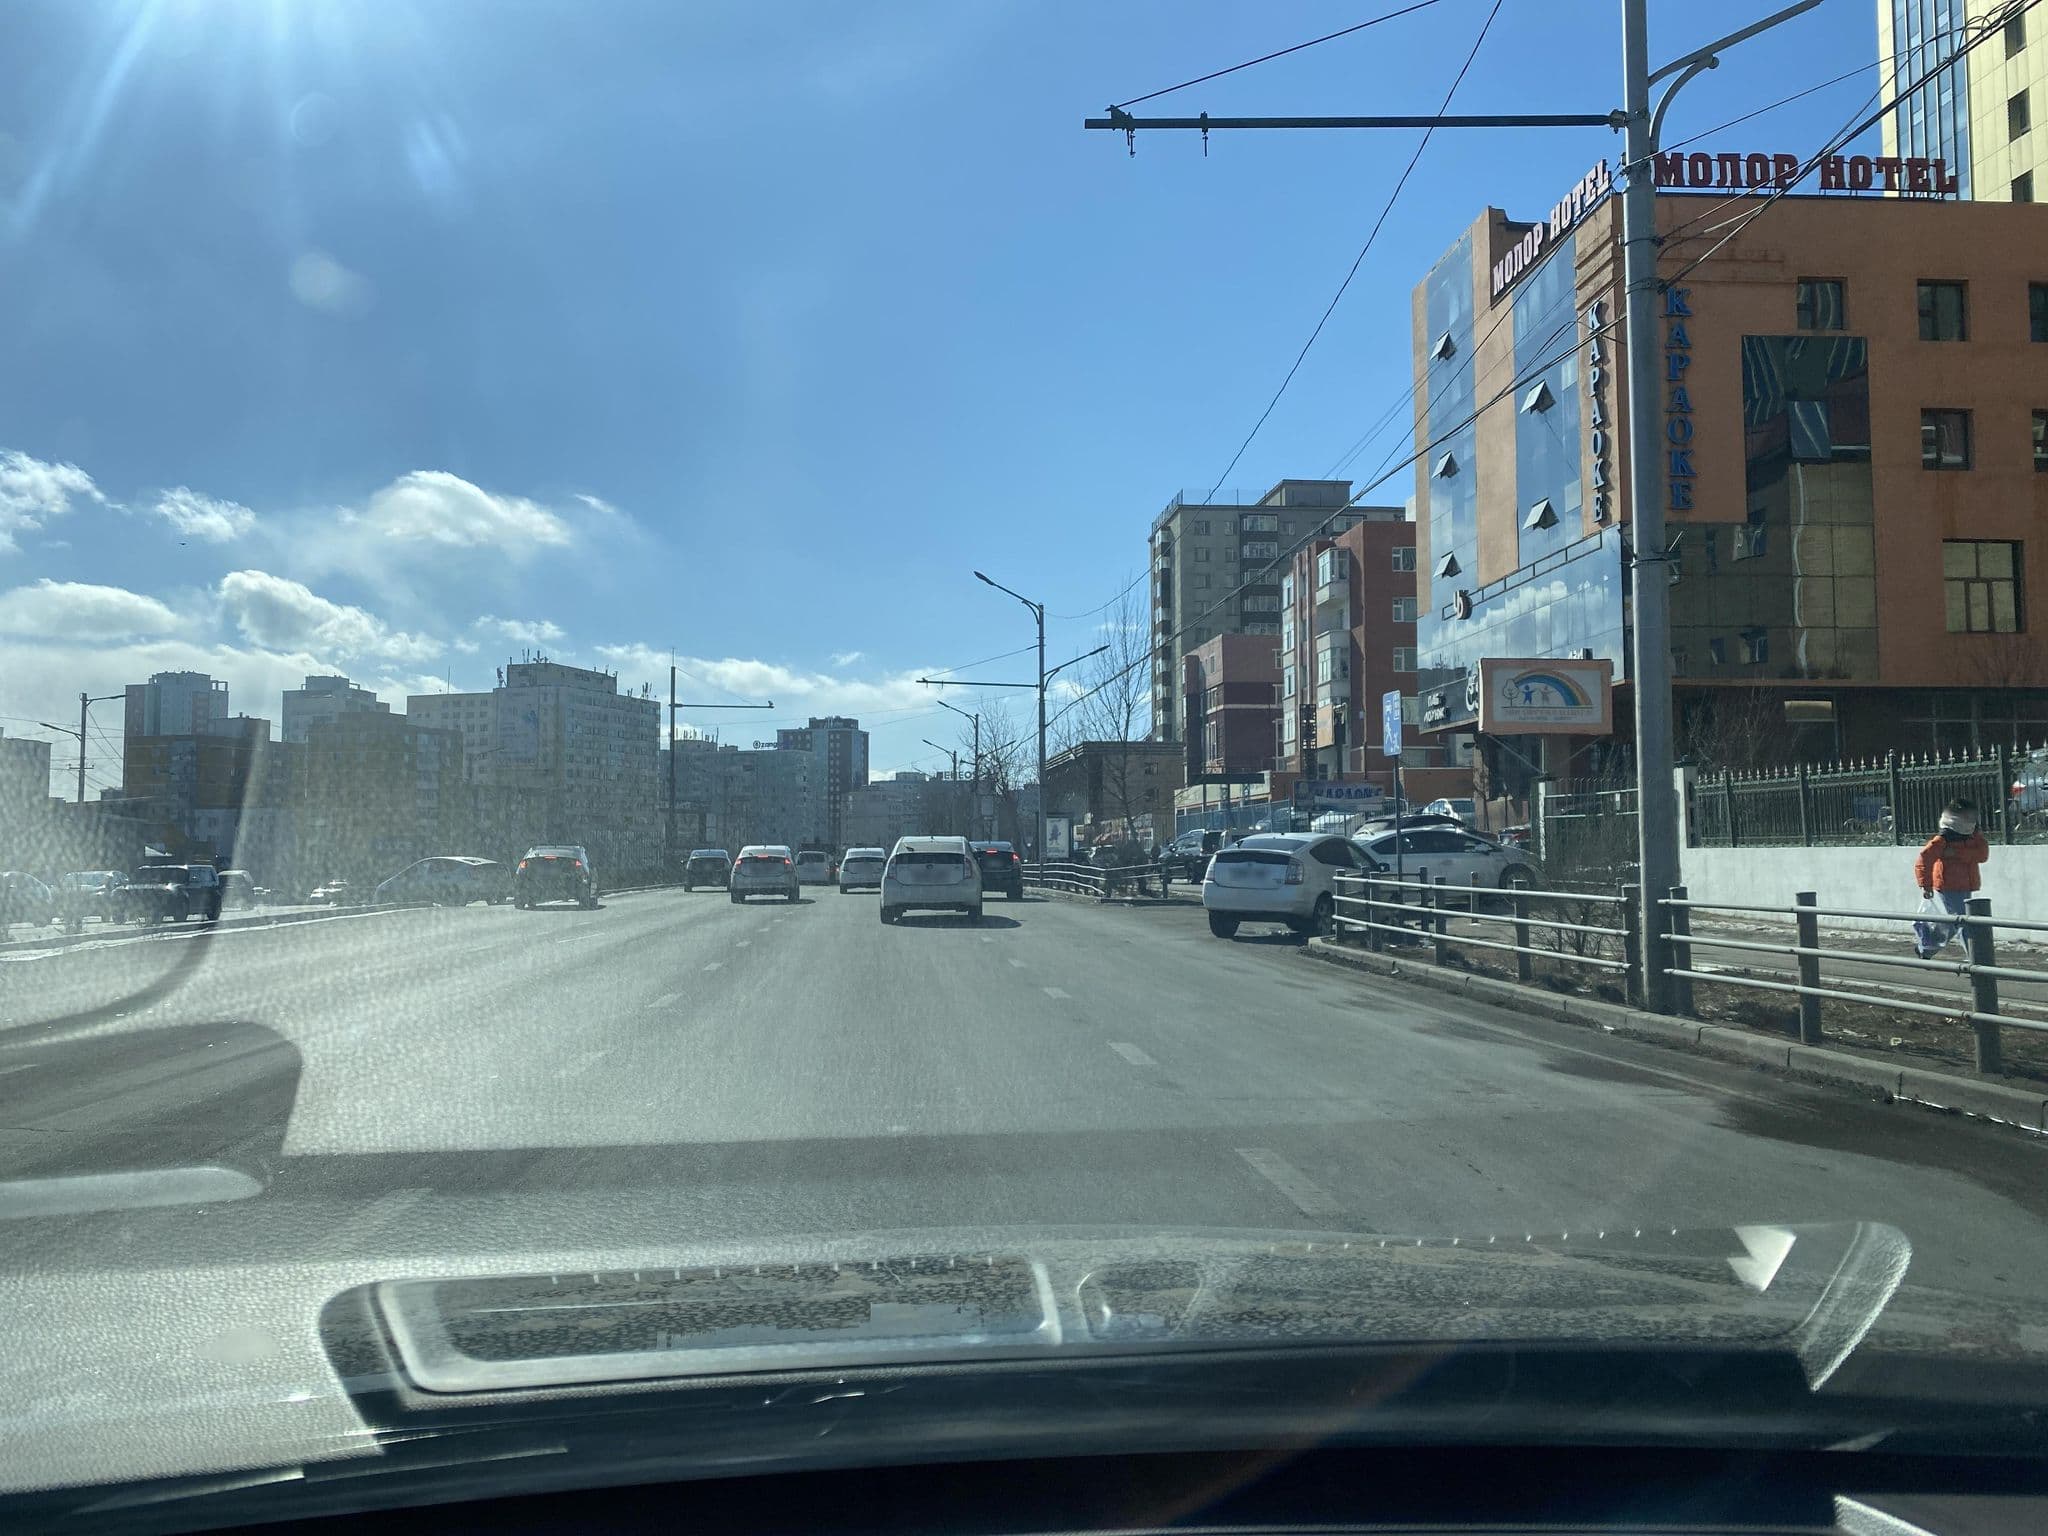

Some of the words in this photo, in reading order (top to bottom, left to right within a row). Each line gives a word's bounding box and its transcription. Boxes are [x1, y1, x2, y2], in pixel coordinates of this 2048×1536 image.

[1493, 222, 1544, 296] МОЛОР
[1549, 158, 1611, 241] HOTEL
[1653, 152, 1798, 188] МОЛОР
[1821, 155, 1957, 193] HOTEL
[1588, 300, 1605, 524] КАРАОКЕ
[1663, 287, 1697, 511] КАРАОКЕ
